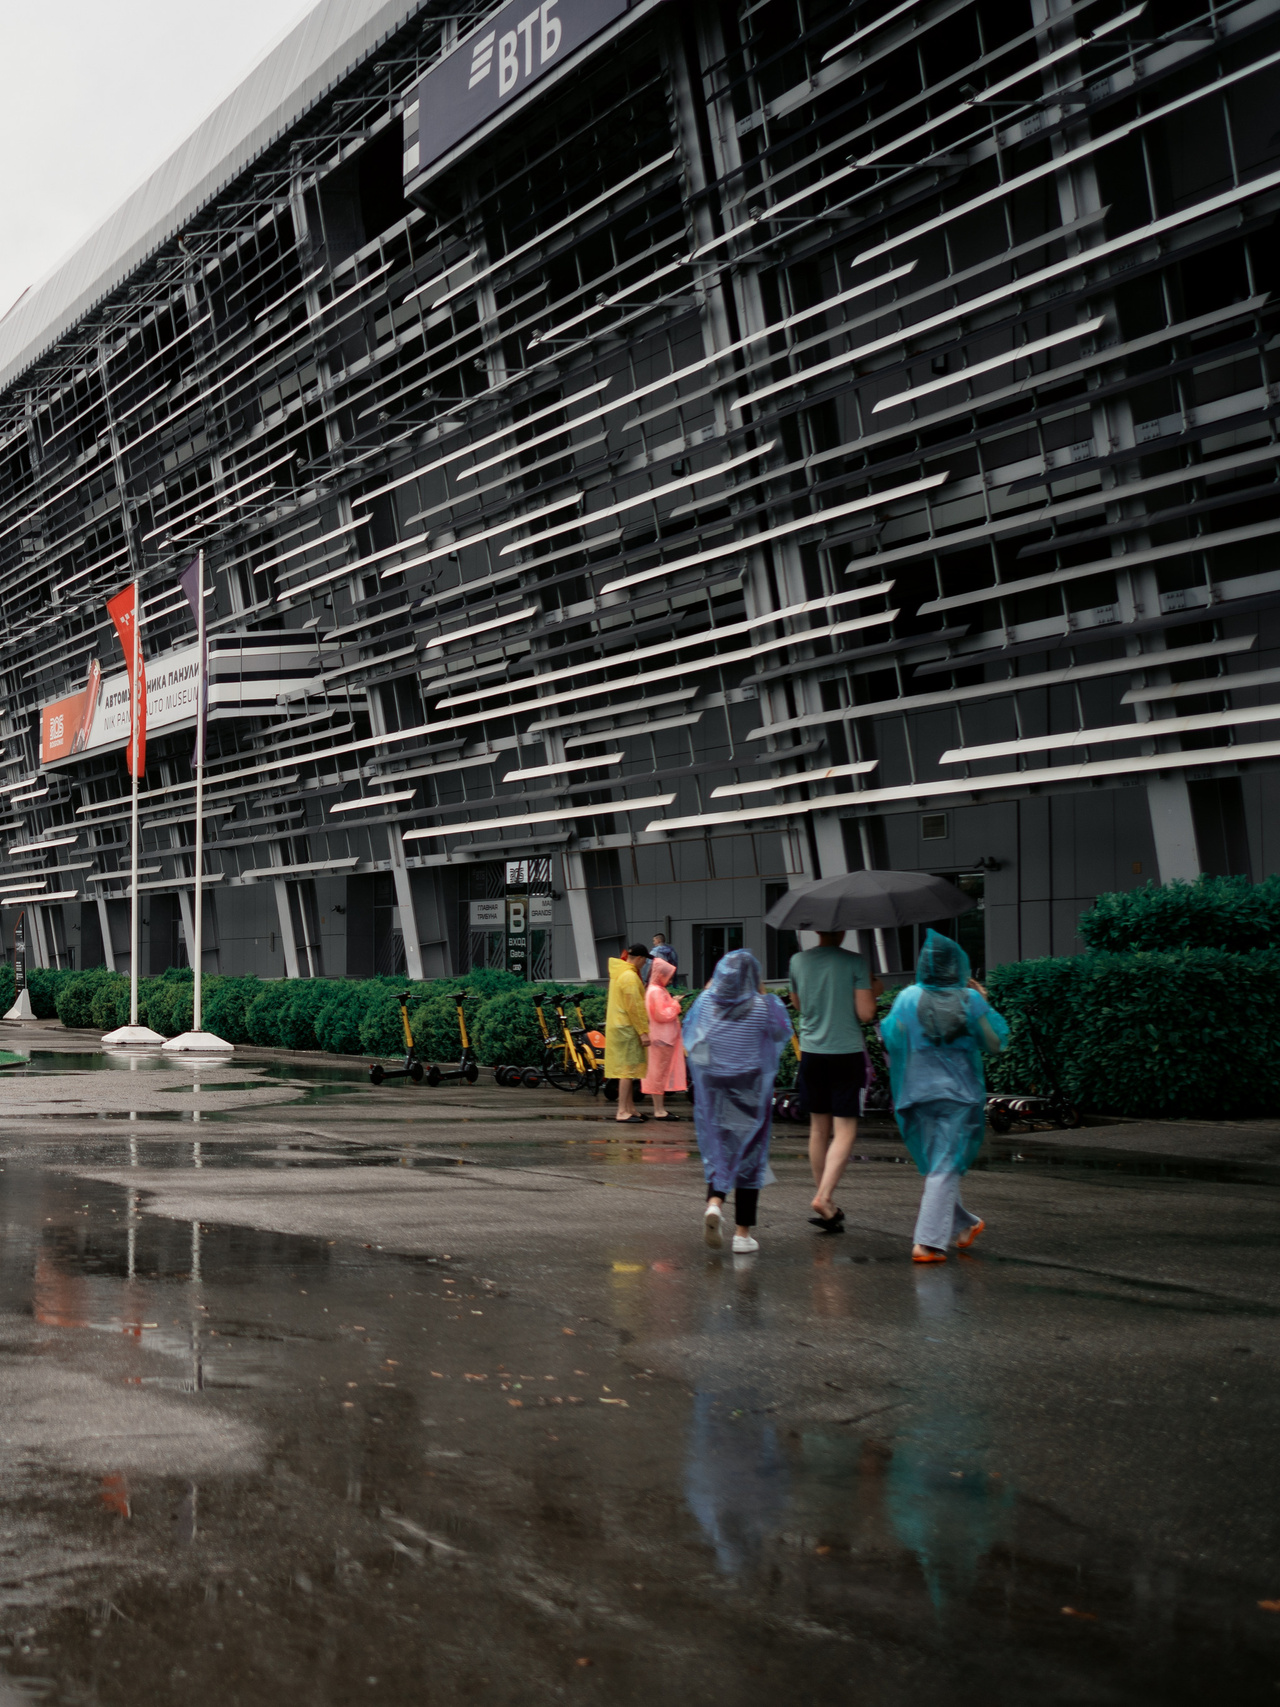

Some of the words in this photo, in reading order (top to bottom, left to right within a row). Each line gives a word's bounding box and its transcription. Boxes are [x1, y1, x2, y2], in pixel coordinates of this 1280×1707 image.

[499, 0, 562, 98] ВТБ
[105, 688, 131, 710] АВТОМУ
[146, 674, 167, 695] НИКА
[104, 714, 116, 731] NIK
[117, 710, 131, 727] PAN
[146, 698, 163, 717] UTO
[531, 909, 552, 917] GRANDS
[508, 937, 526, 947] ВХОД
[509, 949, 524, 958] Gate
